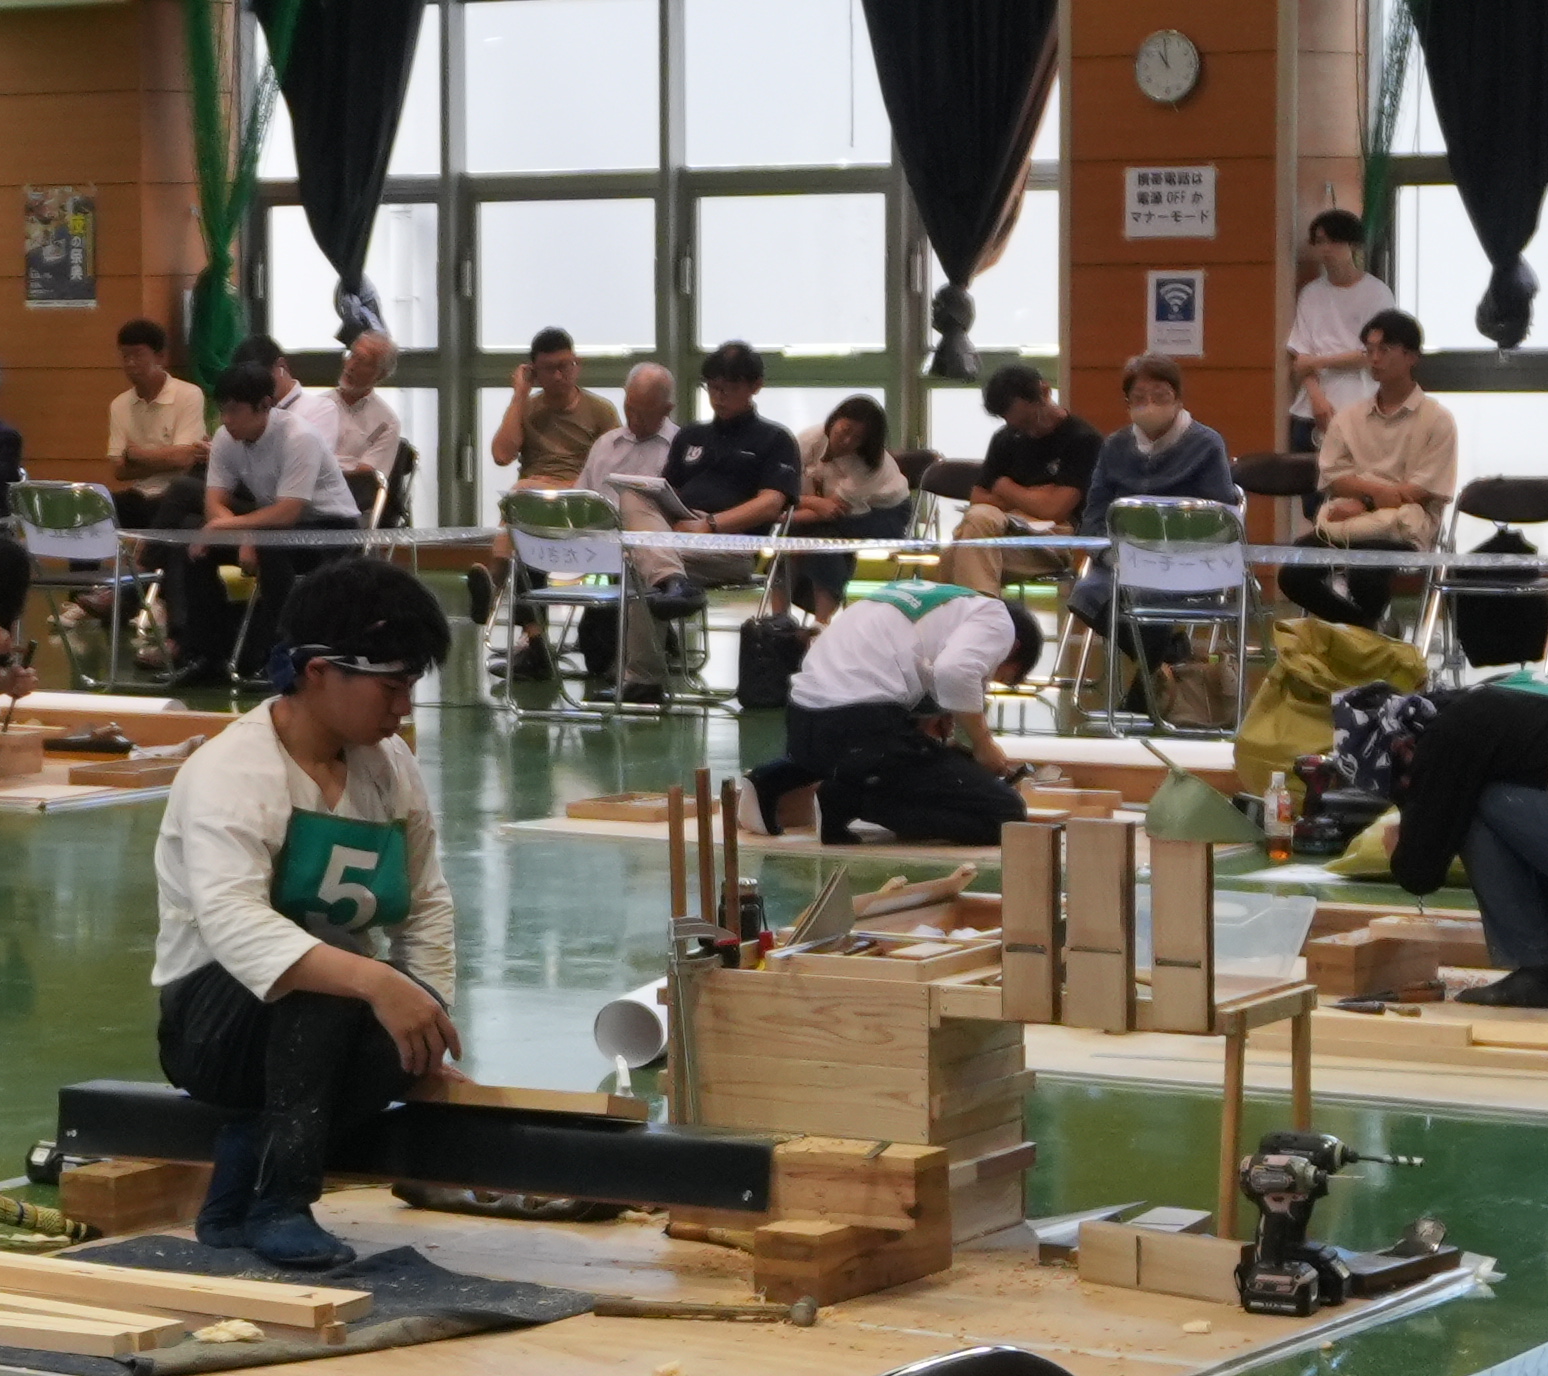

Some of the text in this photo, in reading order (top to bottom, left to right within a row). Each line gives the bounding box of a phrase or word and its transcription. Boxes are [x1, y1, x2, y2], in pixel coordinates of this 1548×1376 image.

[1137, 172, 1203, 188] 携帯電話は
[1166, 191, 1186, 204] OFF
[1130, 210, 1210, 224] マナーモード
[305, 844, 379, 937] 5
